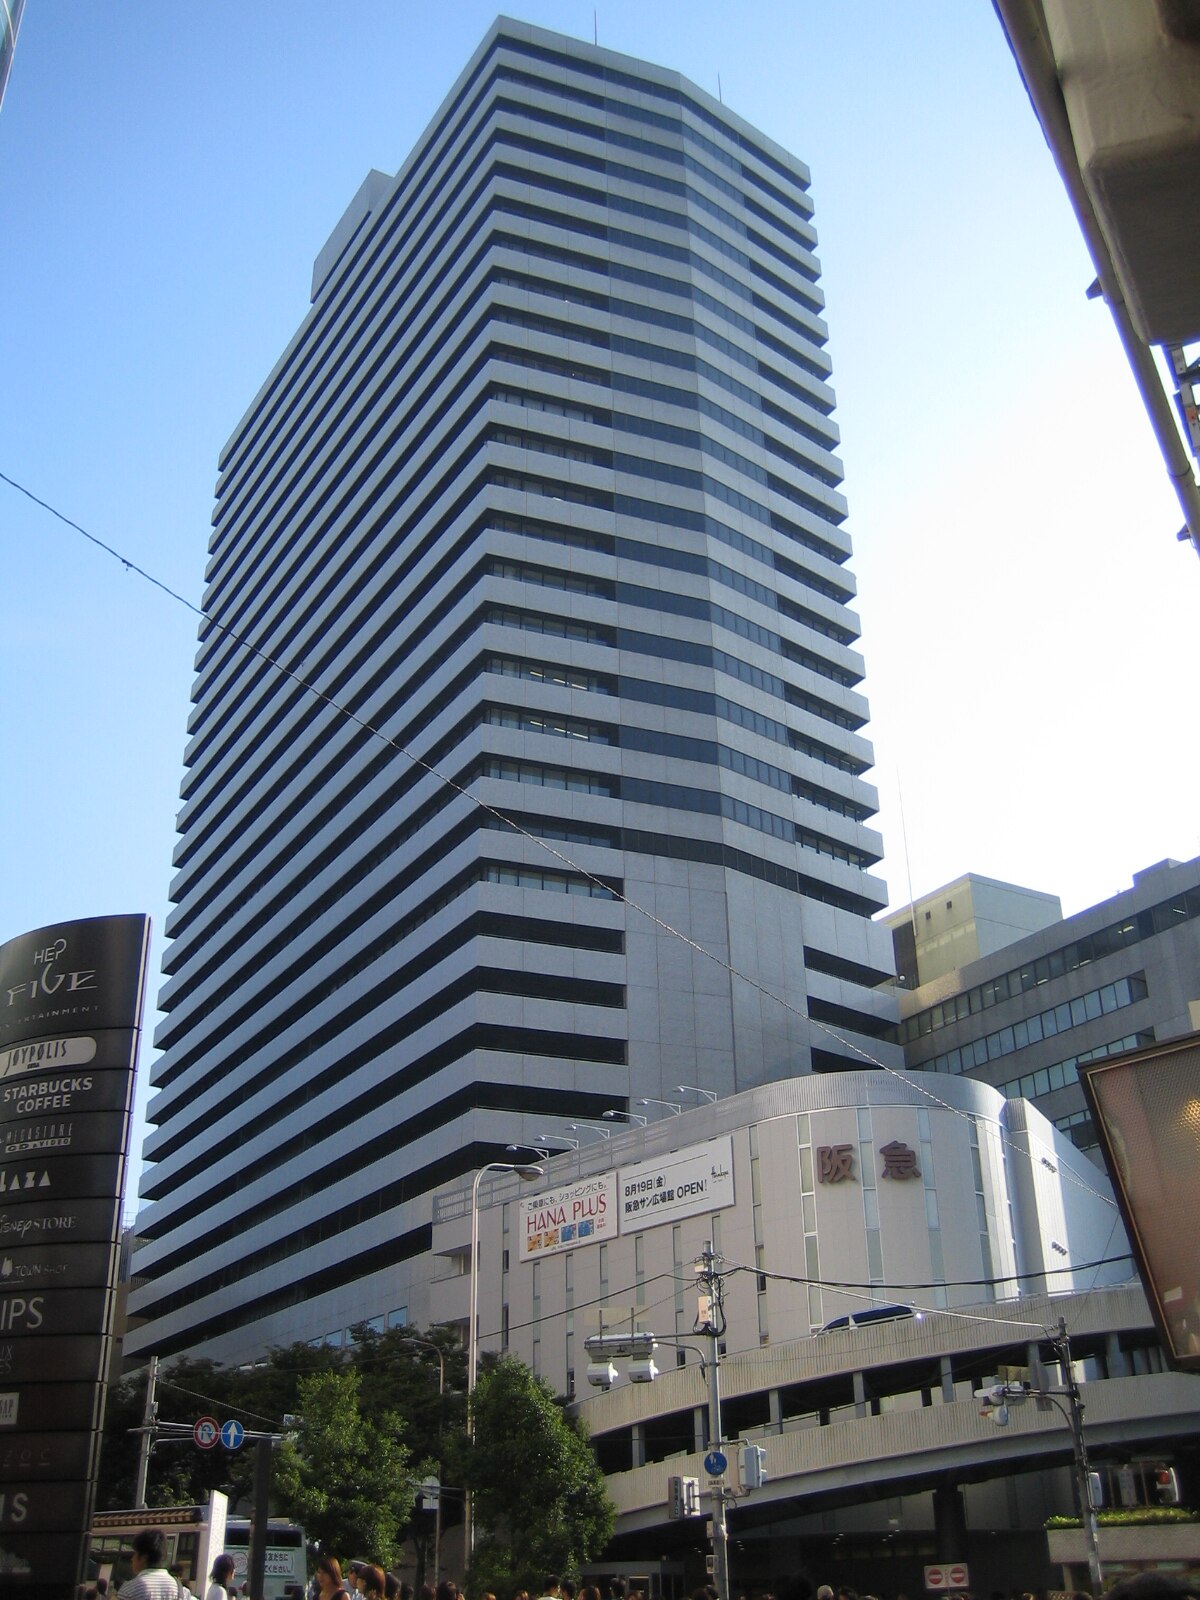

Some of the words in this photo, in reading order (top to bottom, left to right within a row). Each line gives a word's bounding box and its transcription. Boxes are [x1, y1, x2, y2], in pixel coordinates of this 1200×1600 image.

[33, 938, 67, 965] HEP
[6, 963, 98, 1007] FIVE
[4, 1077, 93, 1102] STARBUCKS
[16, 1094, 72, 1113] COFFEE
[6, 1123, 73, 1143] MEGASTORE
[816, 1140, 922, 1184] 阪急
[677, 1179, 708, 1199] OPEN!
[34, 1216, 76, 1230] STORE
[527, 1206, 567, 1234] HANA
[573, 1193, 607, 1221] PLUS
